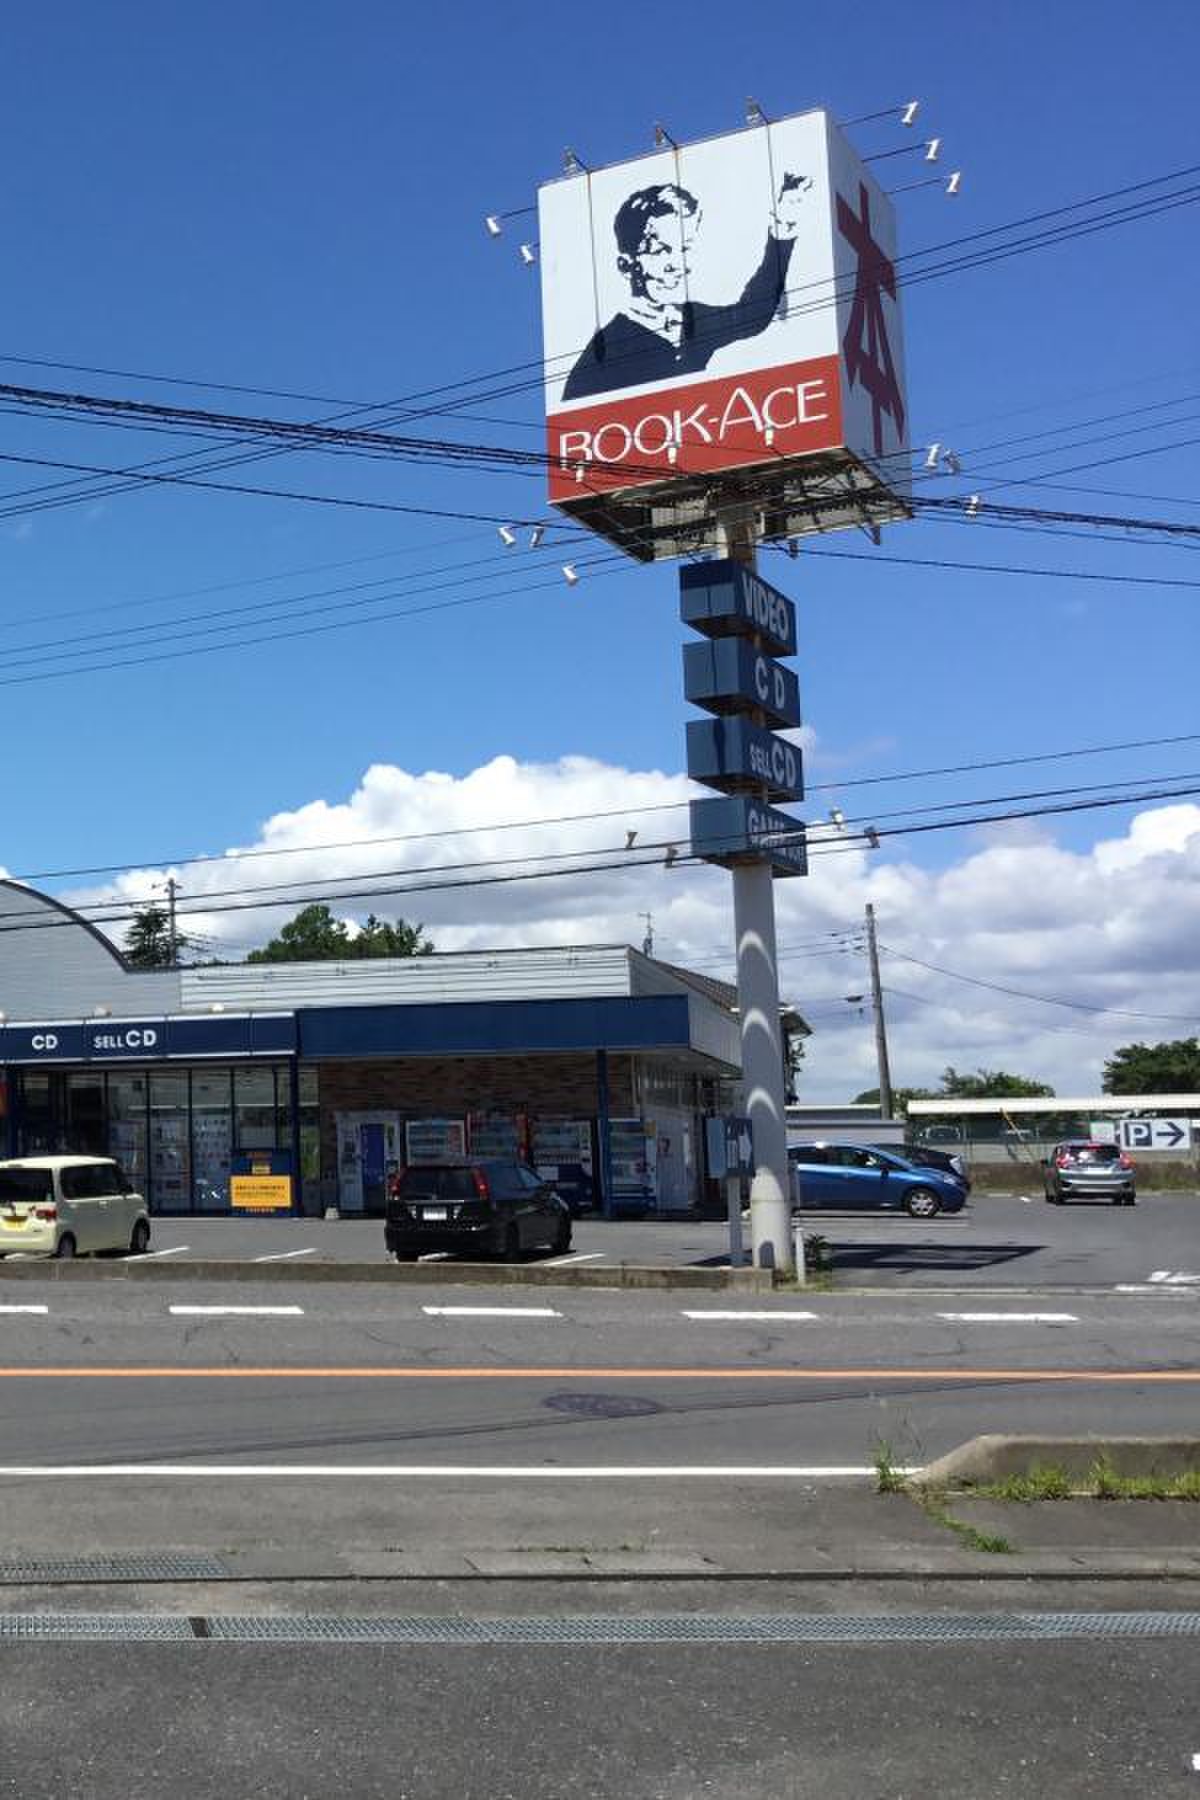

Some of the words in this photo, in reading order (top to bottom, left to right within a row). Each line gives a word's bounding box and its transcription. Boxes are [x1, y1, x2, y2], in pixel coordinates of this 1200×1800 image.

[741, 570, 789, 641] VIDEO
[771, 741, 797, 788] CD
[31, 1034, 59, 1050] CD
[93, 1035, 124, 1049] SELL
[125, 1029, 157, 1047] CD
[1127, 1123, 1150, 1146] P
